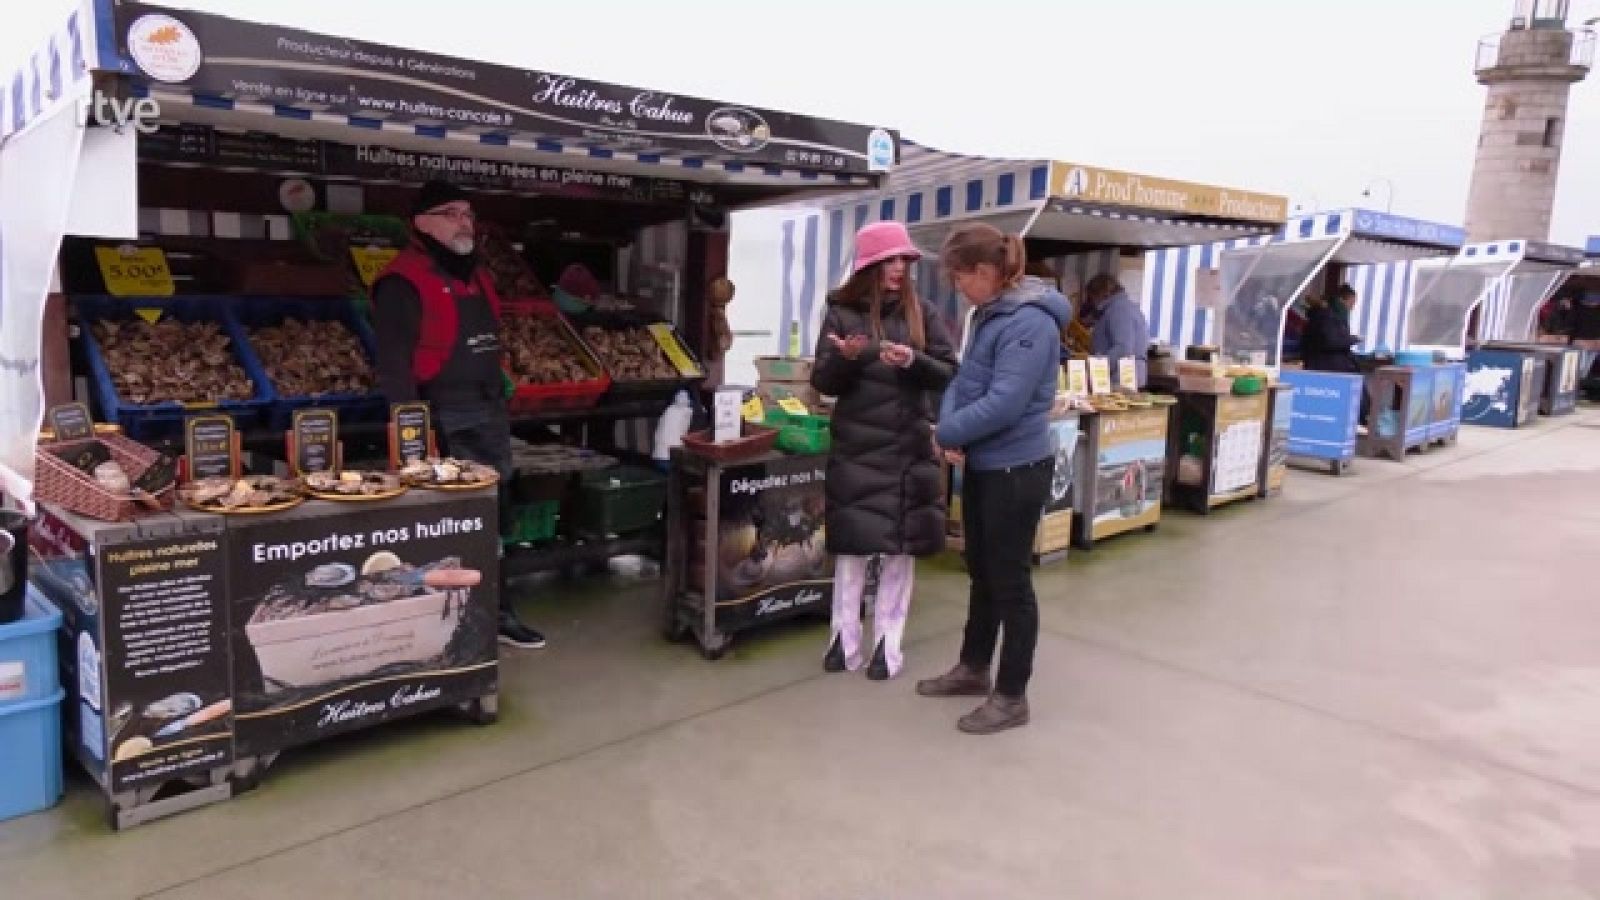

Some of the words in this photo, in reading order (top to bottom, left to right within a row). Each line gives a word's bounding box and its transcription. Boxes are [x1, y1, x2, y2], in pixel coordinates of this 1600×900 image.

[277, 37, 351, 60] Producteur
[353, 51, 395, 68] depuis
[232, 79, 273, 97] Vente
[275, 86, 293, 97] en
[532, 74, 622, 114] Huîtres
[630, 91, 694, 123] Cahue
[356, 145, 416, 166] Huîtres
[419, 154, 498, 176] naturelles
[539, 169, 558, 181] en
[562, 168, 604, 187] pleine
[607, 176, 632, 187] mer
[730, 476, 788, 496] Dégustez
[790, 471, 811, 485] nos
[155, 540, 218, 557] naturelles
[252, 532, 366, 564] Emportez
[371, 526, 411, 547] nos
[415, 516, 484, 540] huîtres
[317, 700, 387, 728] Huîtres
[390, 684, 441, 709] Cahue
